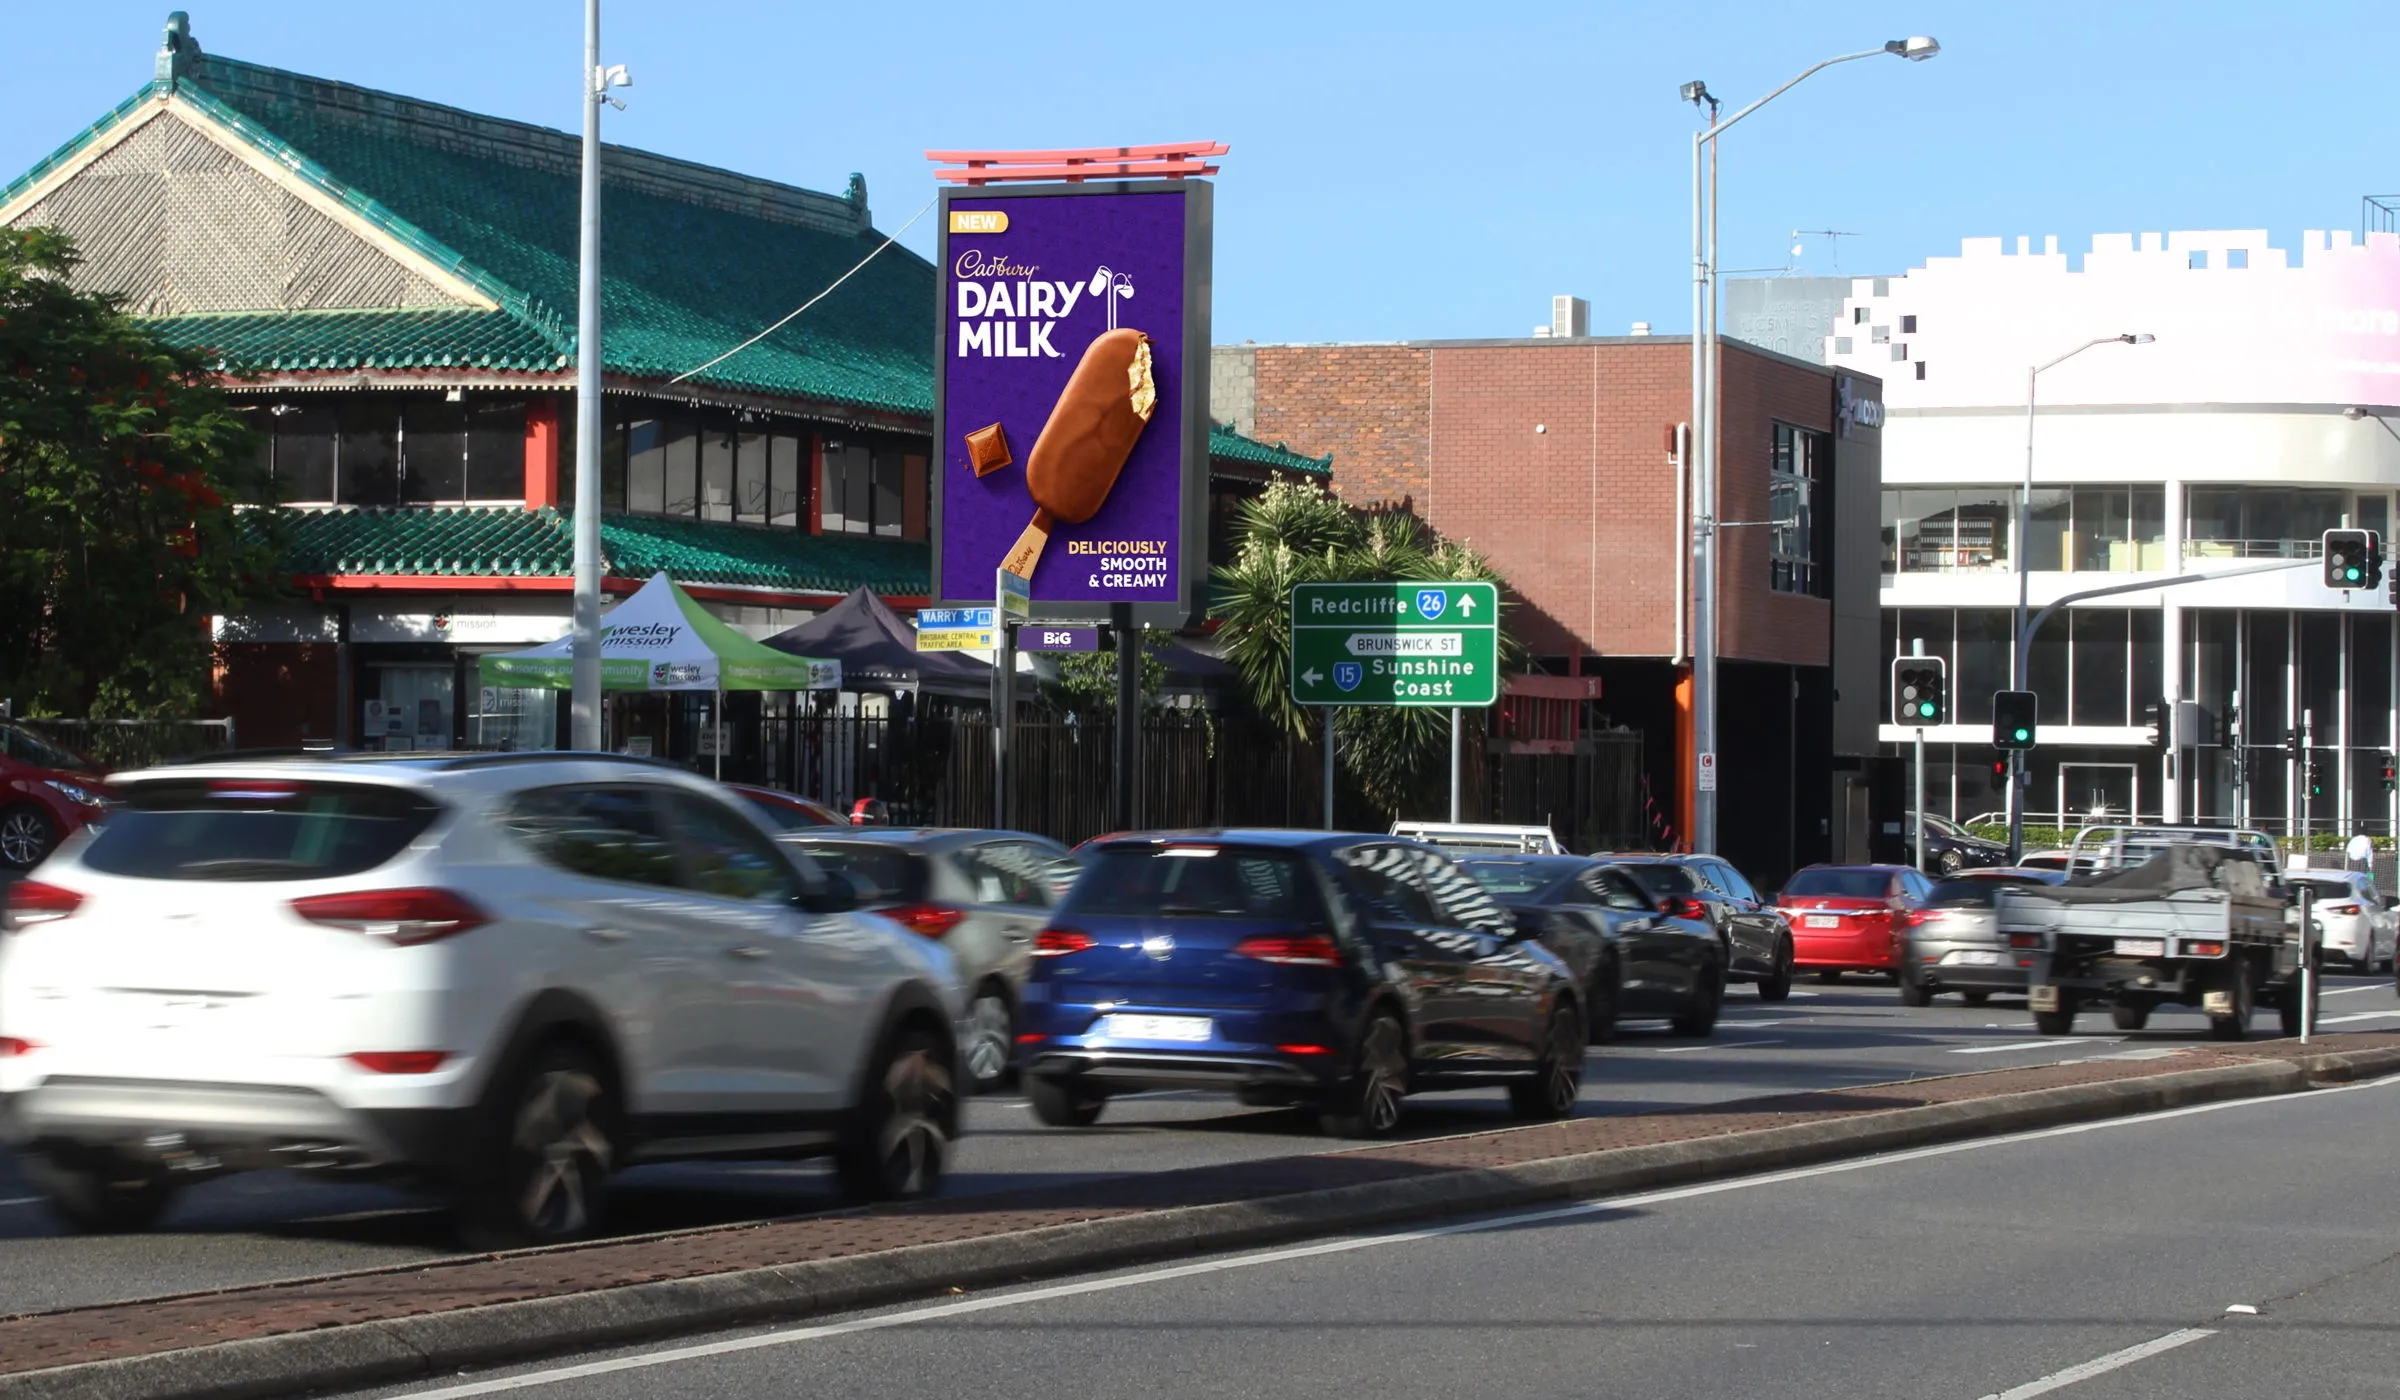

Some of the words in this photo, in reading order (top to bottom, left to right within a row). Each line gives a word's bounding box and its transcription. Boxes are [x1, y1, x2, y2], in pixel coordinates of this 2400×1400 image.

[958, 215, 996, 229] NEW
[955, 250, 1034, 283] Cadbury
[958, 281, 1086, 317] DAIRY
[958, 321, 1061, 357] MILK
[1068, 541, 1167, 554] DELICIOUSLY
[1100, 557, 1167, 571] SMOOTH
[1089, 574, 1099, 587] &
[1103, 574, 1167, 587] CREAMY
[1311, 598, 1407, 613] Redcliffe
[1422, 596, 1441, 612] 26
[922, 611, 957, 623] WARRY
[963, 610, 975, 622] ST
[457, 620, 497, 628] mission
[611, 623, 682, 636] wesley
[602, 635, 674, 646] mission
[951, 632, 977, 640] CENTRAL
[920, 641, 944, 649] TRAFFIC
[947, 640, 962, 648] AREA
[1357, 638, 1432, 650] BRUNSWICK
[1441, 638, 1456, 649] ST
[559, 666, 573, 674] ou
[671, 664, 700, 676] wesley
[1340, 667, 1355, 682] 15
[1372, 659, 1474, 675] Sunshine
[669, 673, 700, 681] mission
[1393, 680, 1452, 696] Coast
